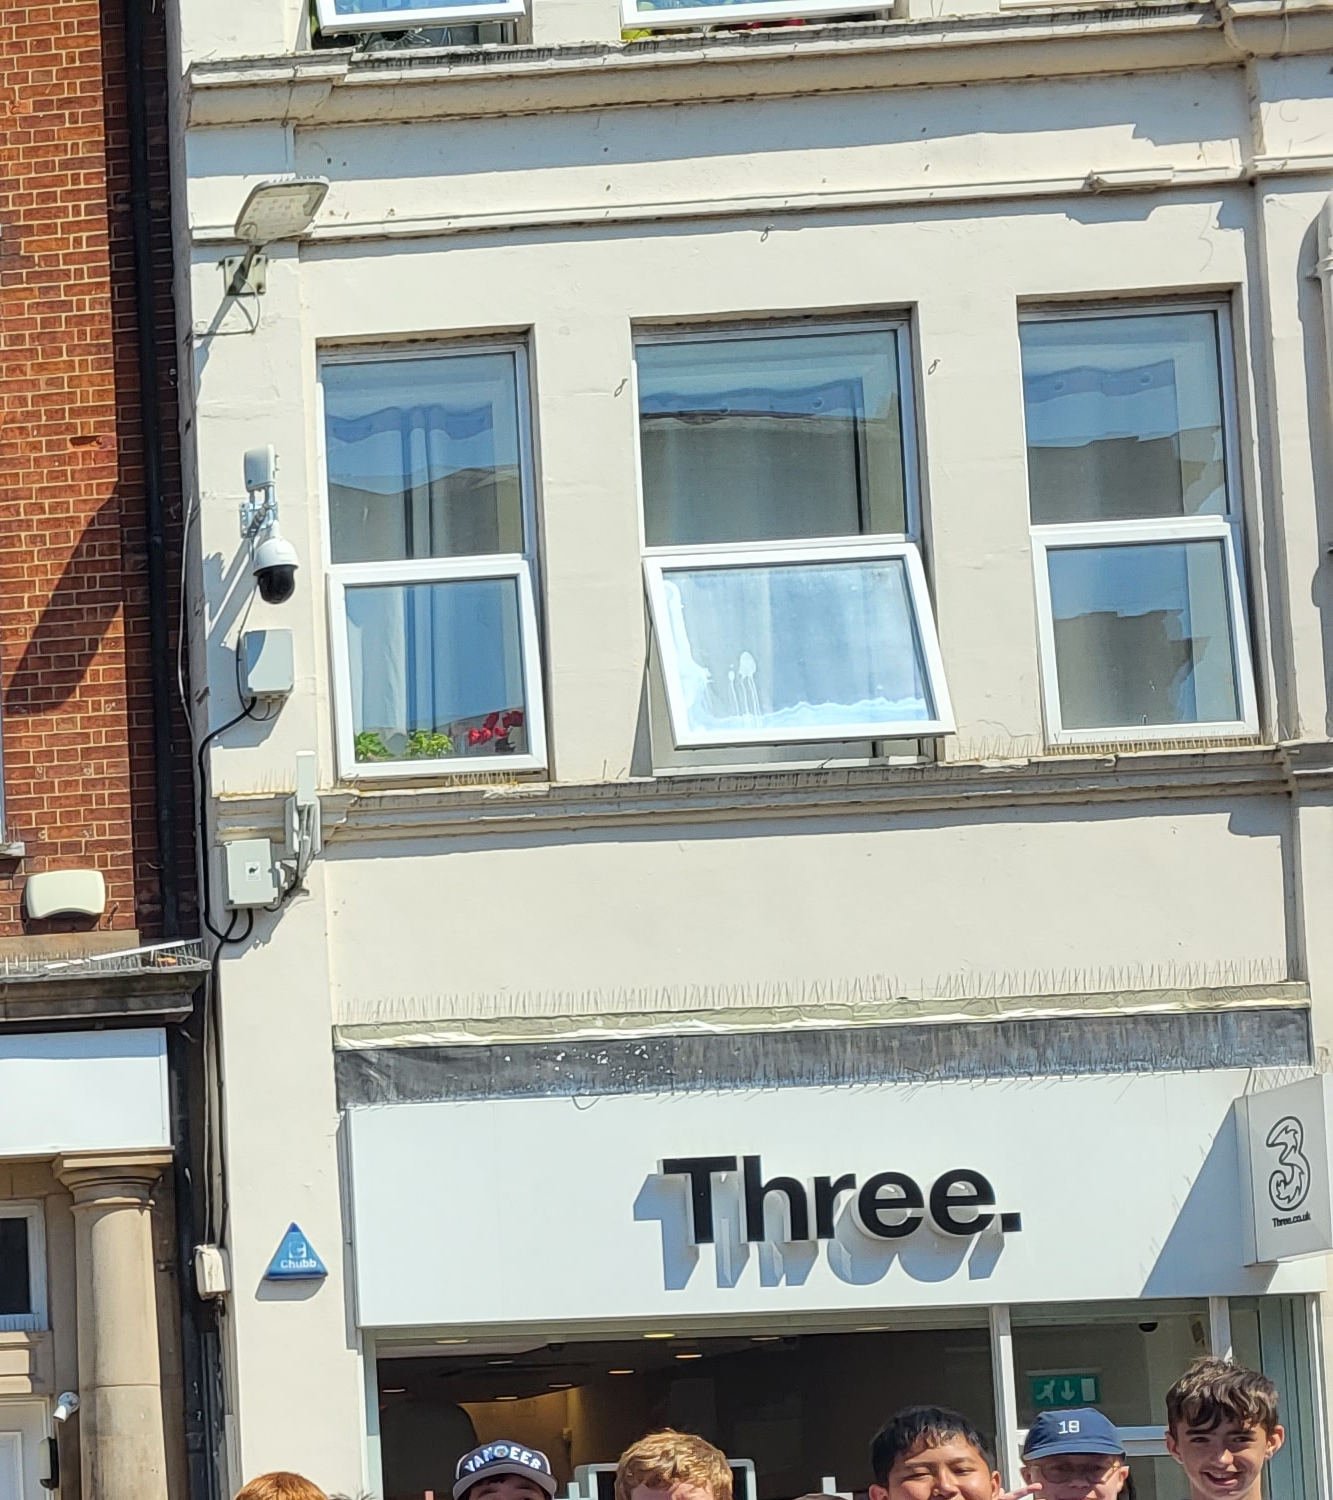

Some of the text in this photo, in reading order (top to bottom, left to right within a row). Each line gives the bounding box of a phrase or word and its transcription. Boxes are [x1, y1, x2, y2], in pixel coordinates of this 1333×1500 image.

[658, 1154, 1023, 1245] Three.
[279, 1257, 317, 1269] Chubb
[464, 1445, 542, 1472] YANEES
